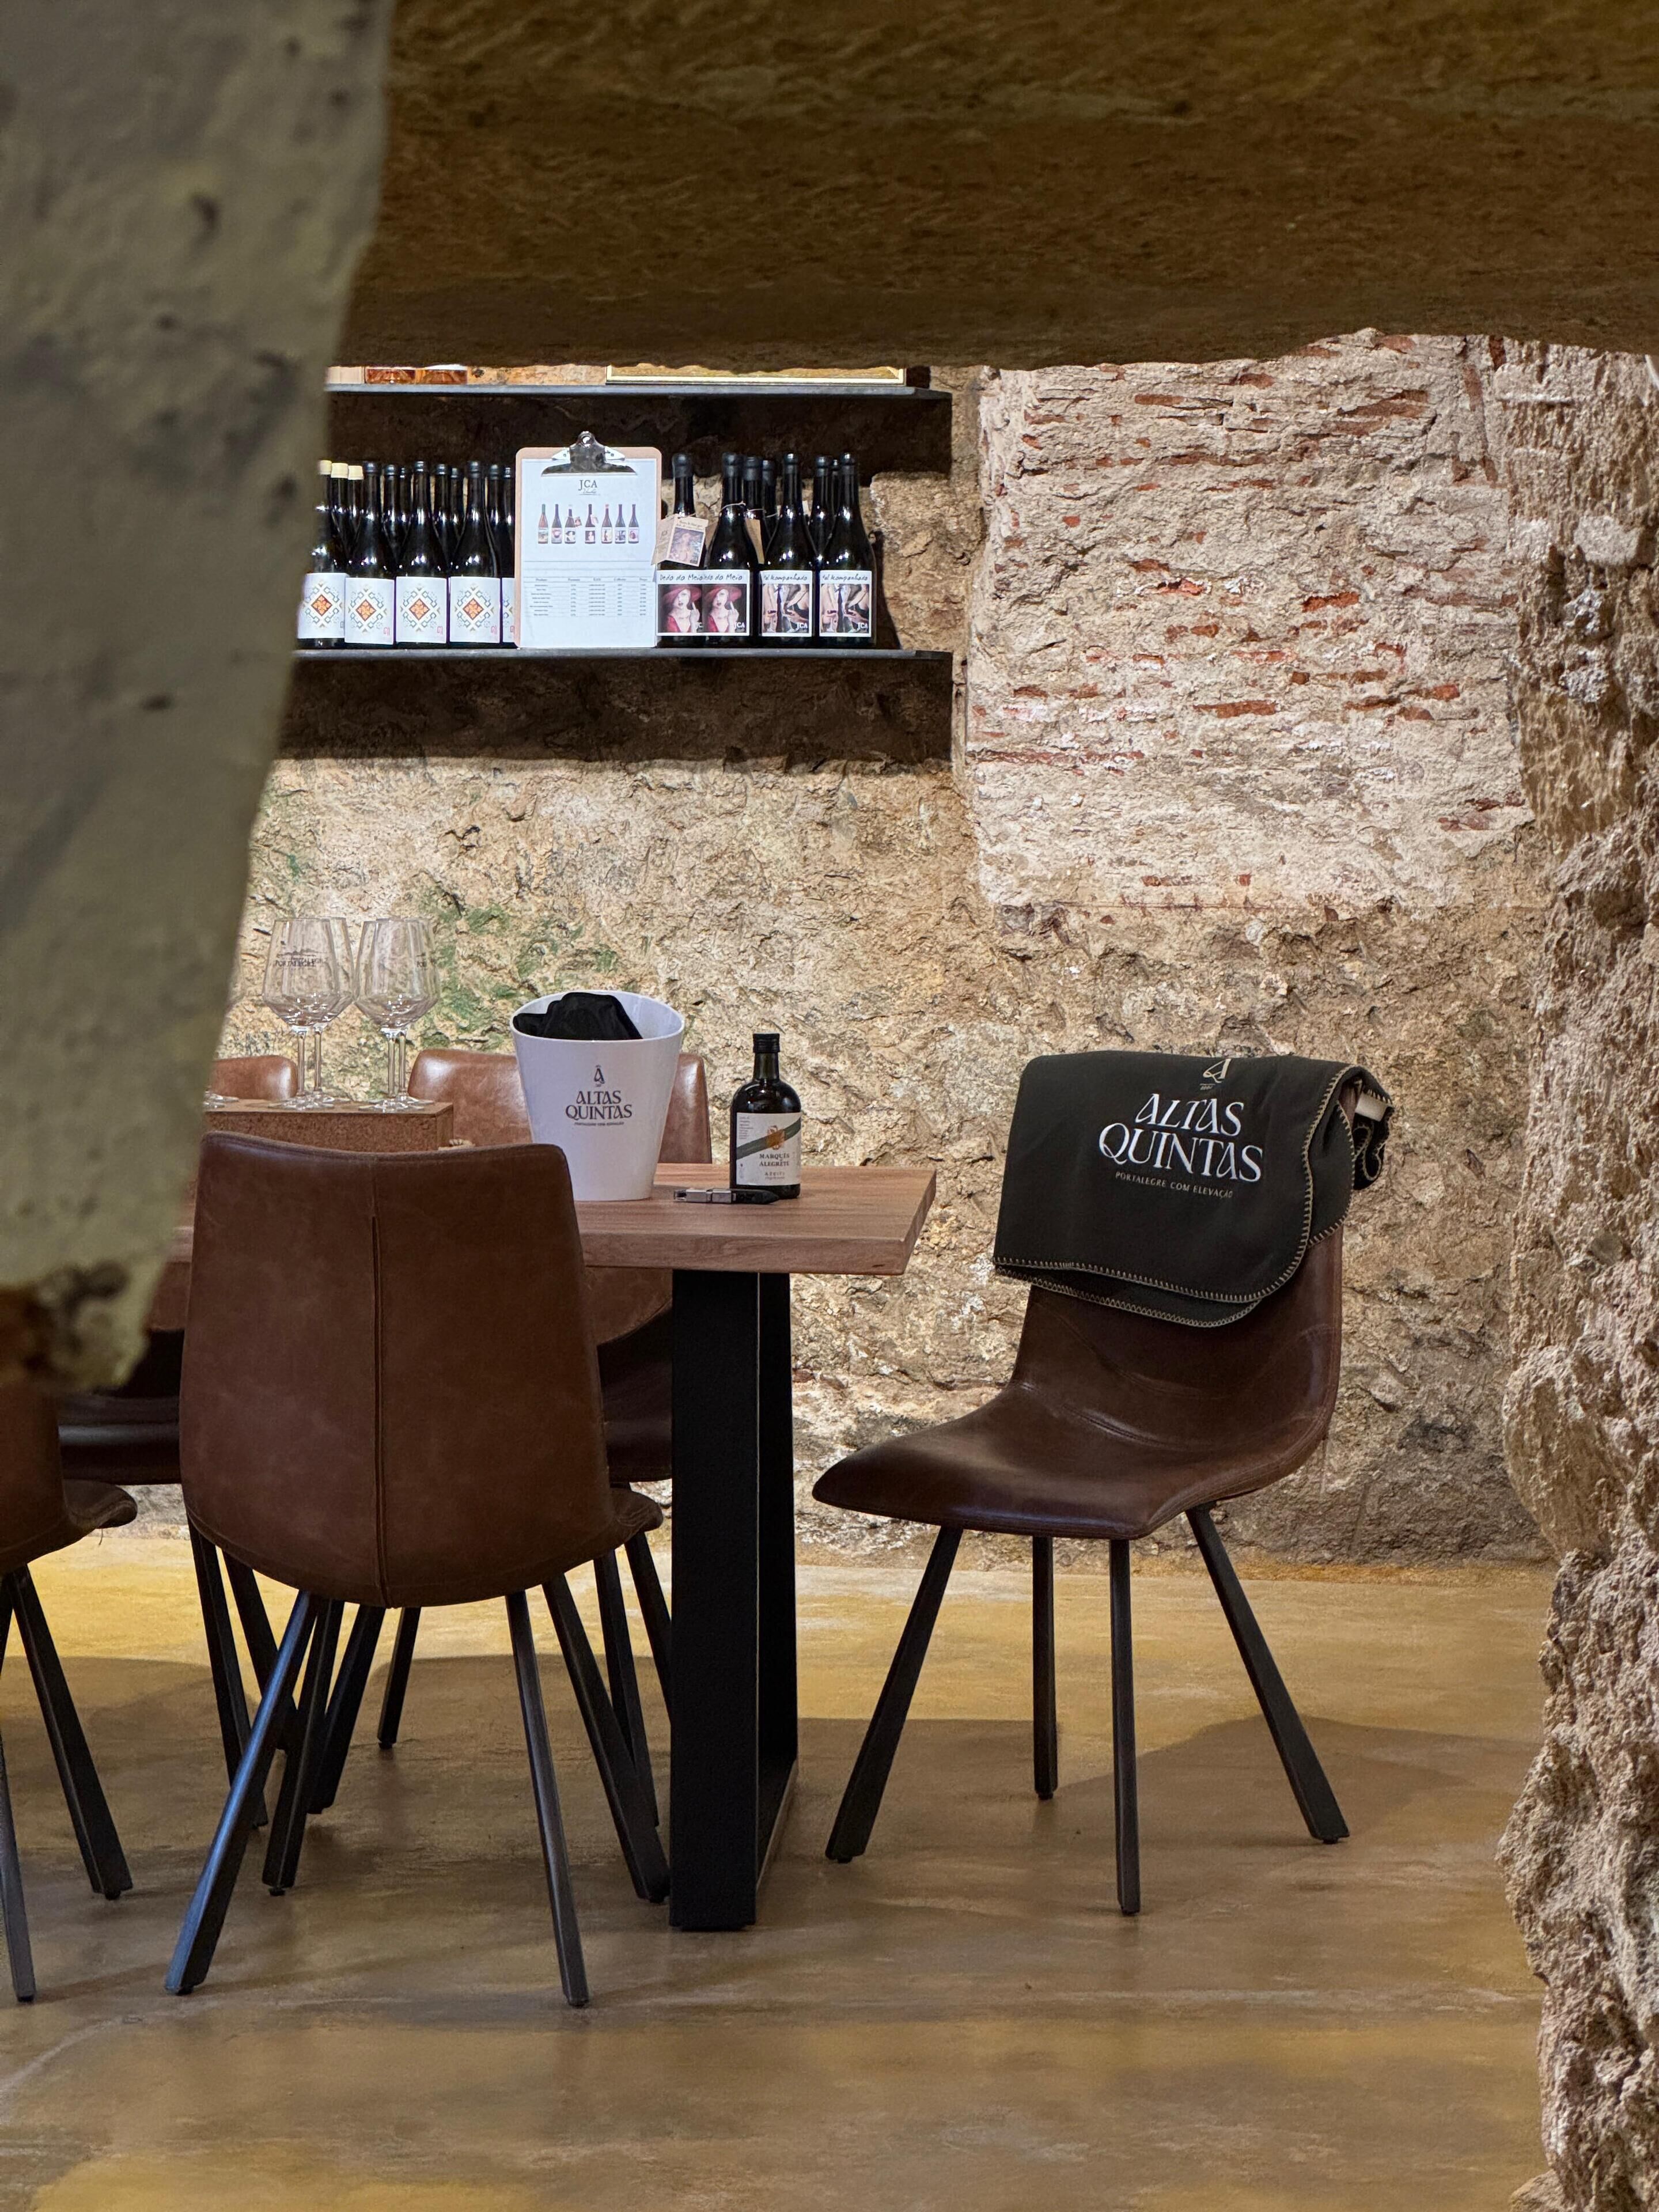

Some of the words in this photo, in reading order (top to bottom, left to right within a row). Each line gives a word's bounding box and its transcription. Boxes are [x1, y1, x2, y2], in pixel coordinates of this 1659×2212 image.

[578, 479, 597, 491] JCA
[576, 1090, 622, 1104] ALTAS
[566, 1104, 632, 1120] QUINTAS
[1135, 1093, 1244, 1137] ALTAS
[1099, 1123, 1263, 1183] QUINTAS
[1115, 1171, 1167, 1188] PORTALEGRE
[1170, 1181, 1190, 1193] COM
